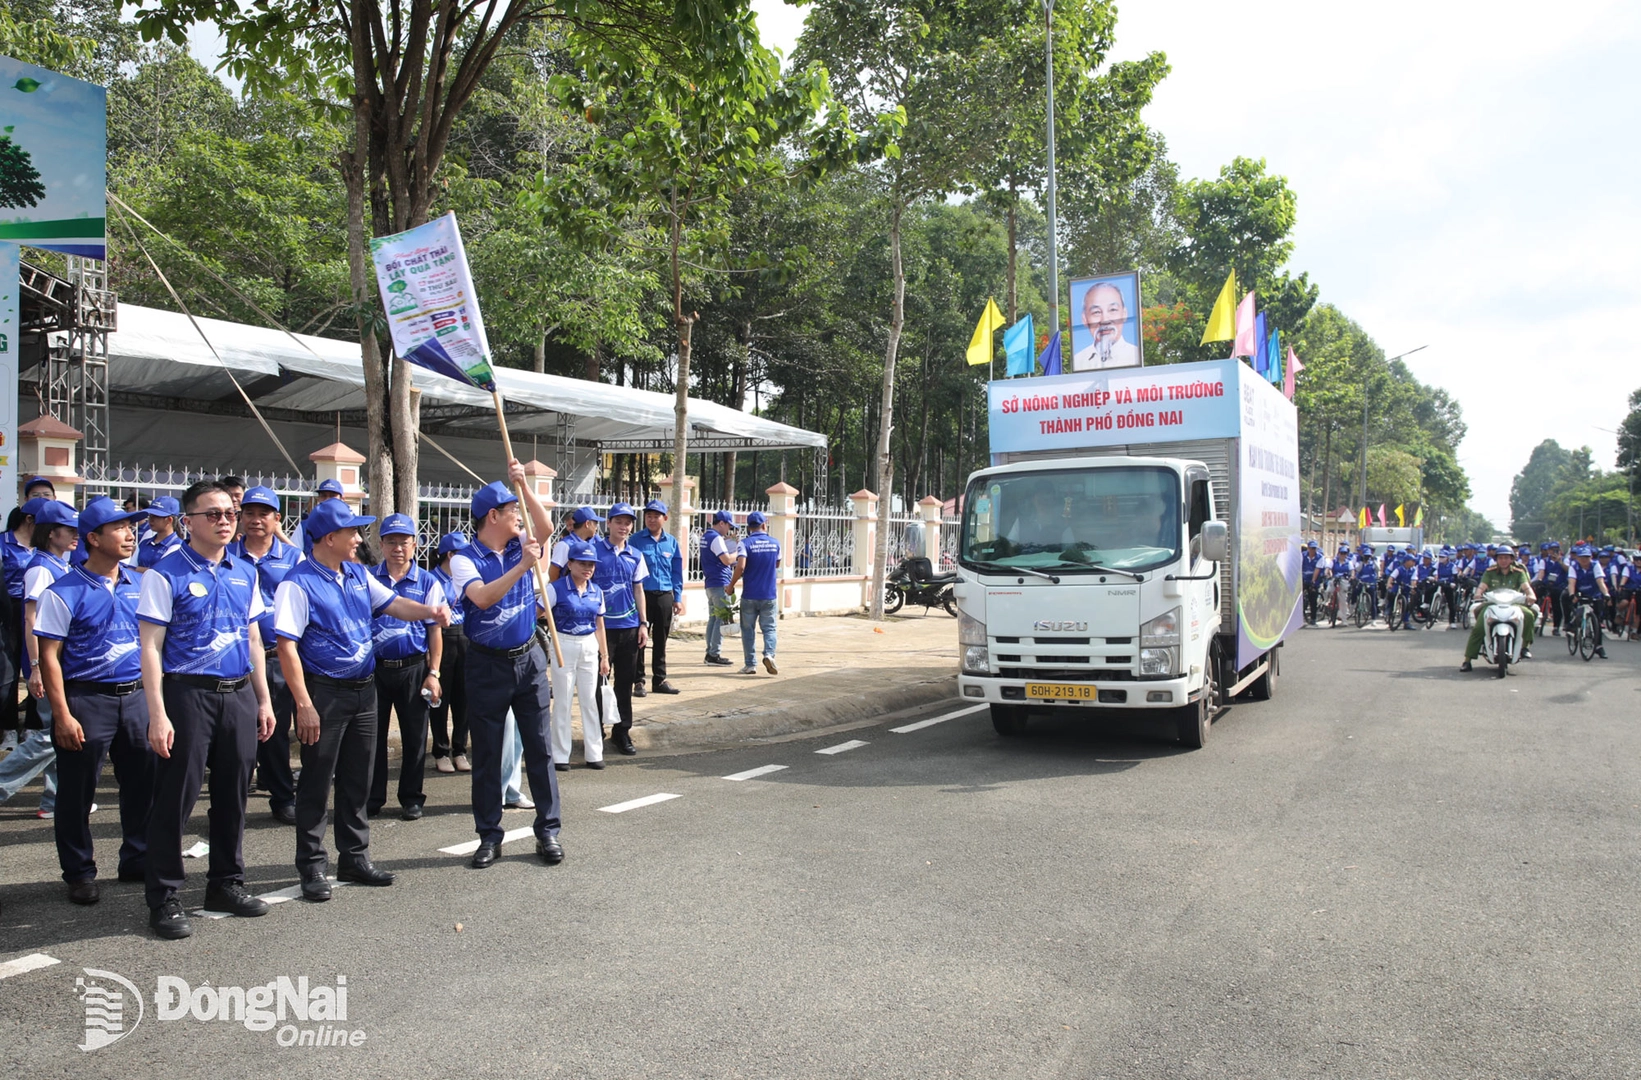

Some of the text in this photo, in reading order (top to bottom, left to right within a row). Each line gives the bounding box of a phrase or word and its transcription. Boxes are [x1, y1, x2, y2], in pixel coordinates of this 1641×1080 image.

[1002, 380, 1224, 414] SỞ NÔNG NGHIỆP VÀ MÔI TRƯỜNG
[1039, 408, 1183, 434] THÀNH PHỐ ĐỒNG NAI
[1033, 621, 1088, 632] ISUZU
[1031, 685, 1090, 697] 60H-219.18
